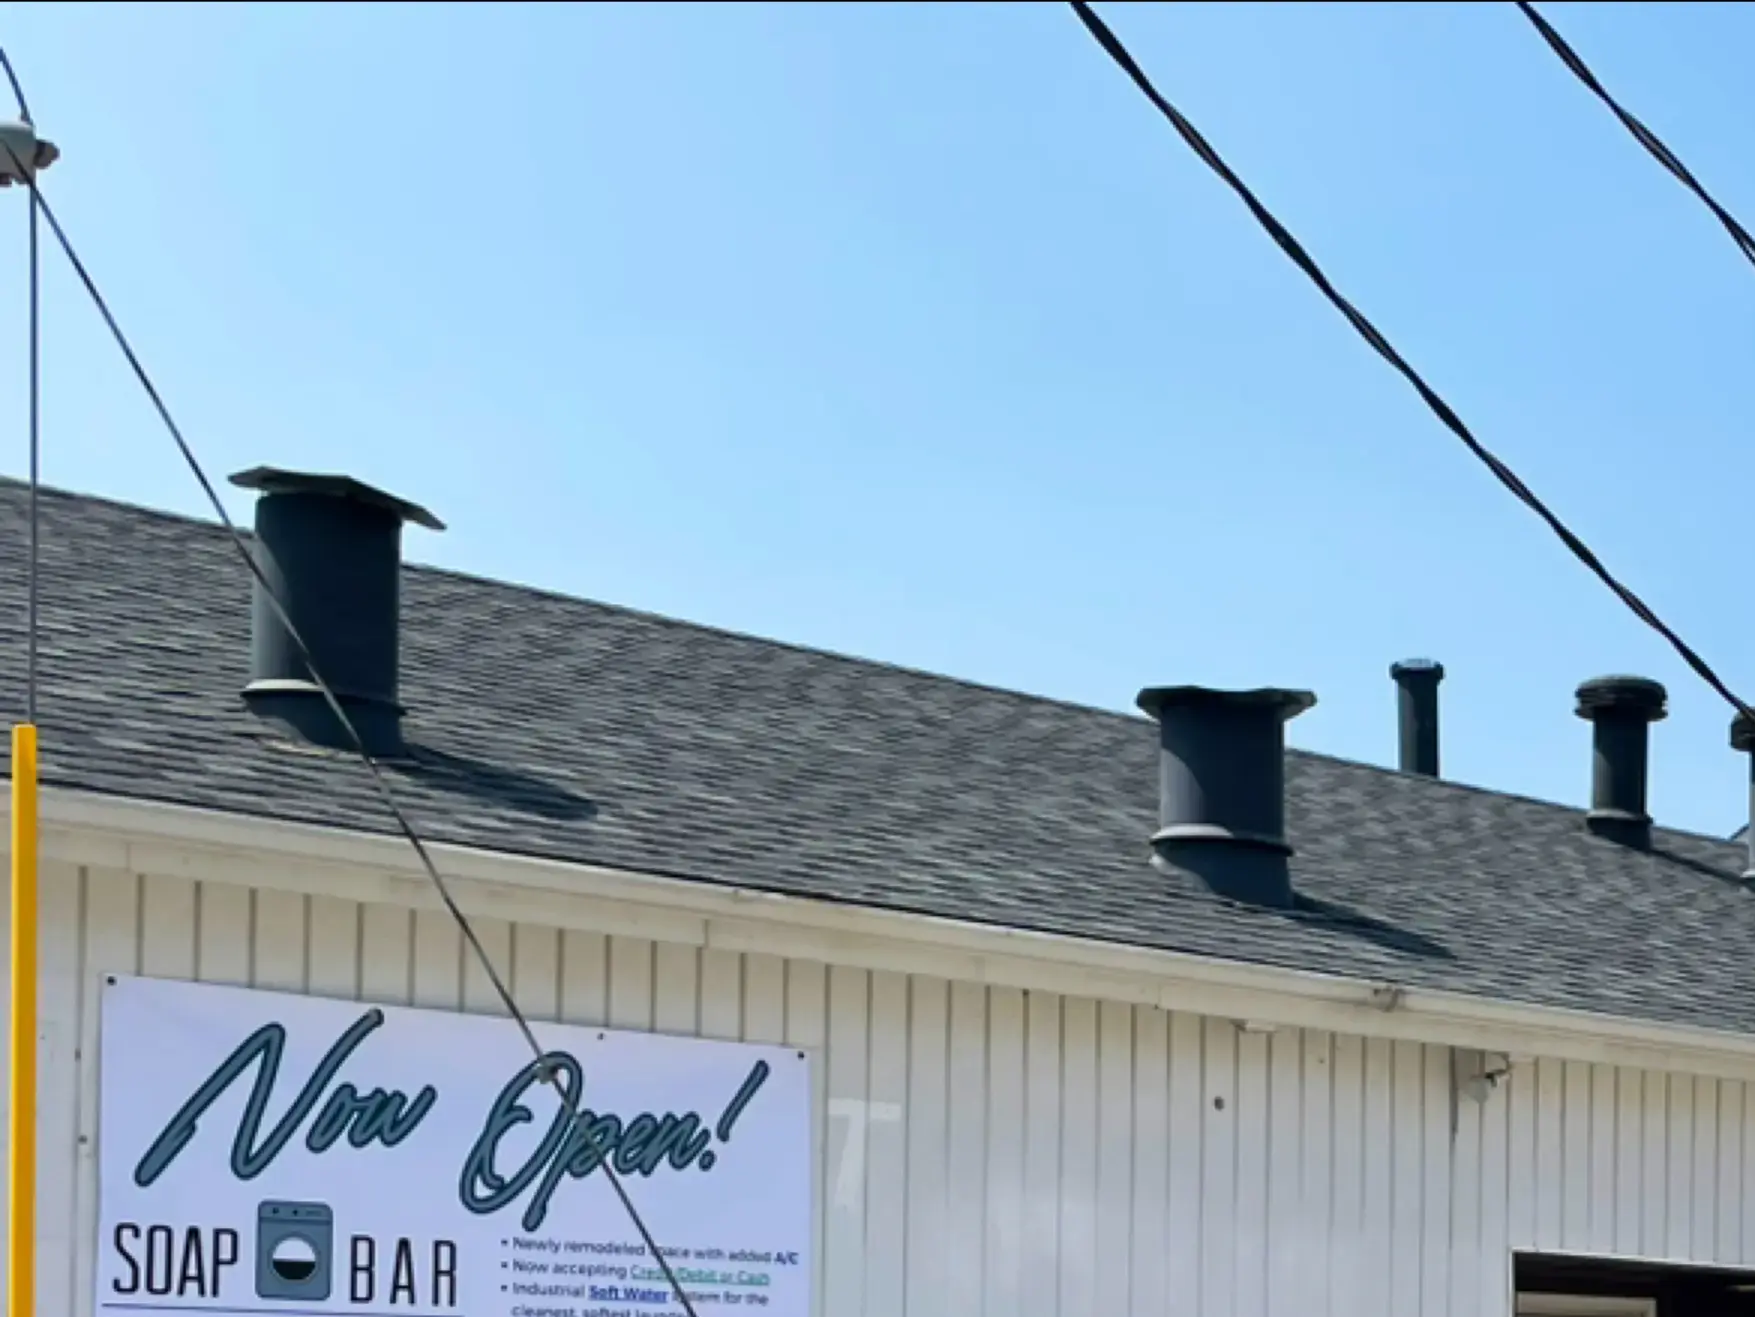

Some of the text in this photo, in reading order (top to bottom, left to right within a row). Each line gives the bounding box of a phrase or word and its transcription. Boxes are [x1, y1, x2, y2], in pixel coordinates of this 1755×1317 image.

[134, 1008, 770, 1232] Now Open!
[112, 1222, 458, 1308] SOAP BAR
[512, 1237, 561, 1253] Newly
[564, 1241, 646, 1256] remodeled
[650, 1245, 690, 1261] pace
[694, 1248, 725, 1260] with
[774, 1251, 799, 1265] A/C
[512, 1259, 549, 1274] Now
[552, 1263, 628, 1280] accepting
[512, 1282, 770, 1306] Industrial Soft Water sstem for the
